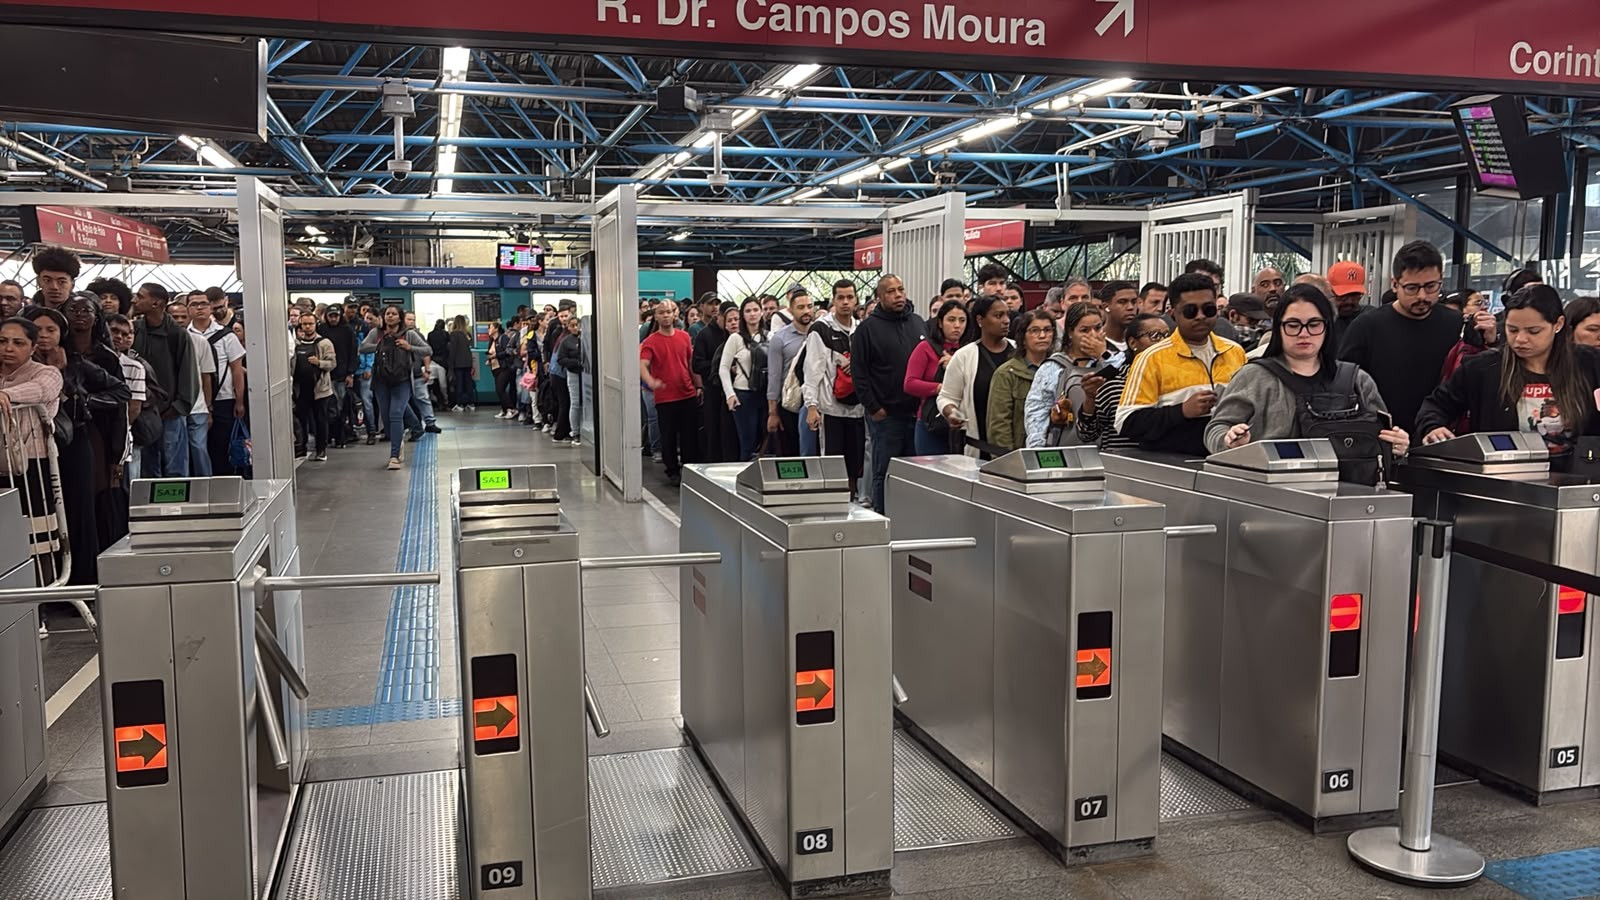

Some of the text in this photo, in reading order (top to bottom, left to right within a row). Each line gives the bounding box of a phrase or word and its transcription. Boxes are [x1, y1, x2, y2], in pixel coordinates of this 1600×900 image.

[597, 0, 1047, 46] R. Dr. Campos Moura
[288, 277, 364, 285] Bilheteria Blindada
[411, 277, 484, 286] Bilheteria Blindada
[532, 278, 569, 286] Bilheteria
[781, 466, 803, 474] SAIR
[482, 476, 507, 484] SAIR
[157, 488, 185, 497] SAIR
[1557, 749, 1576, 765] 05
[1328, 772, 1349, 789] 06
[1080, 799, 1103, 817] 07
[802, 833, 828, 850] 08
[488, 866, 517, 885] 09
